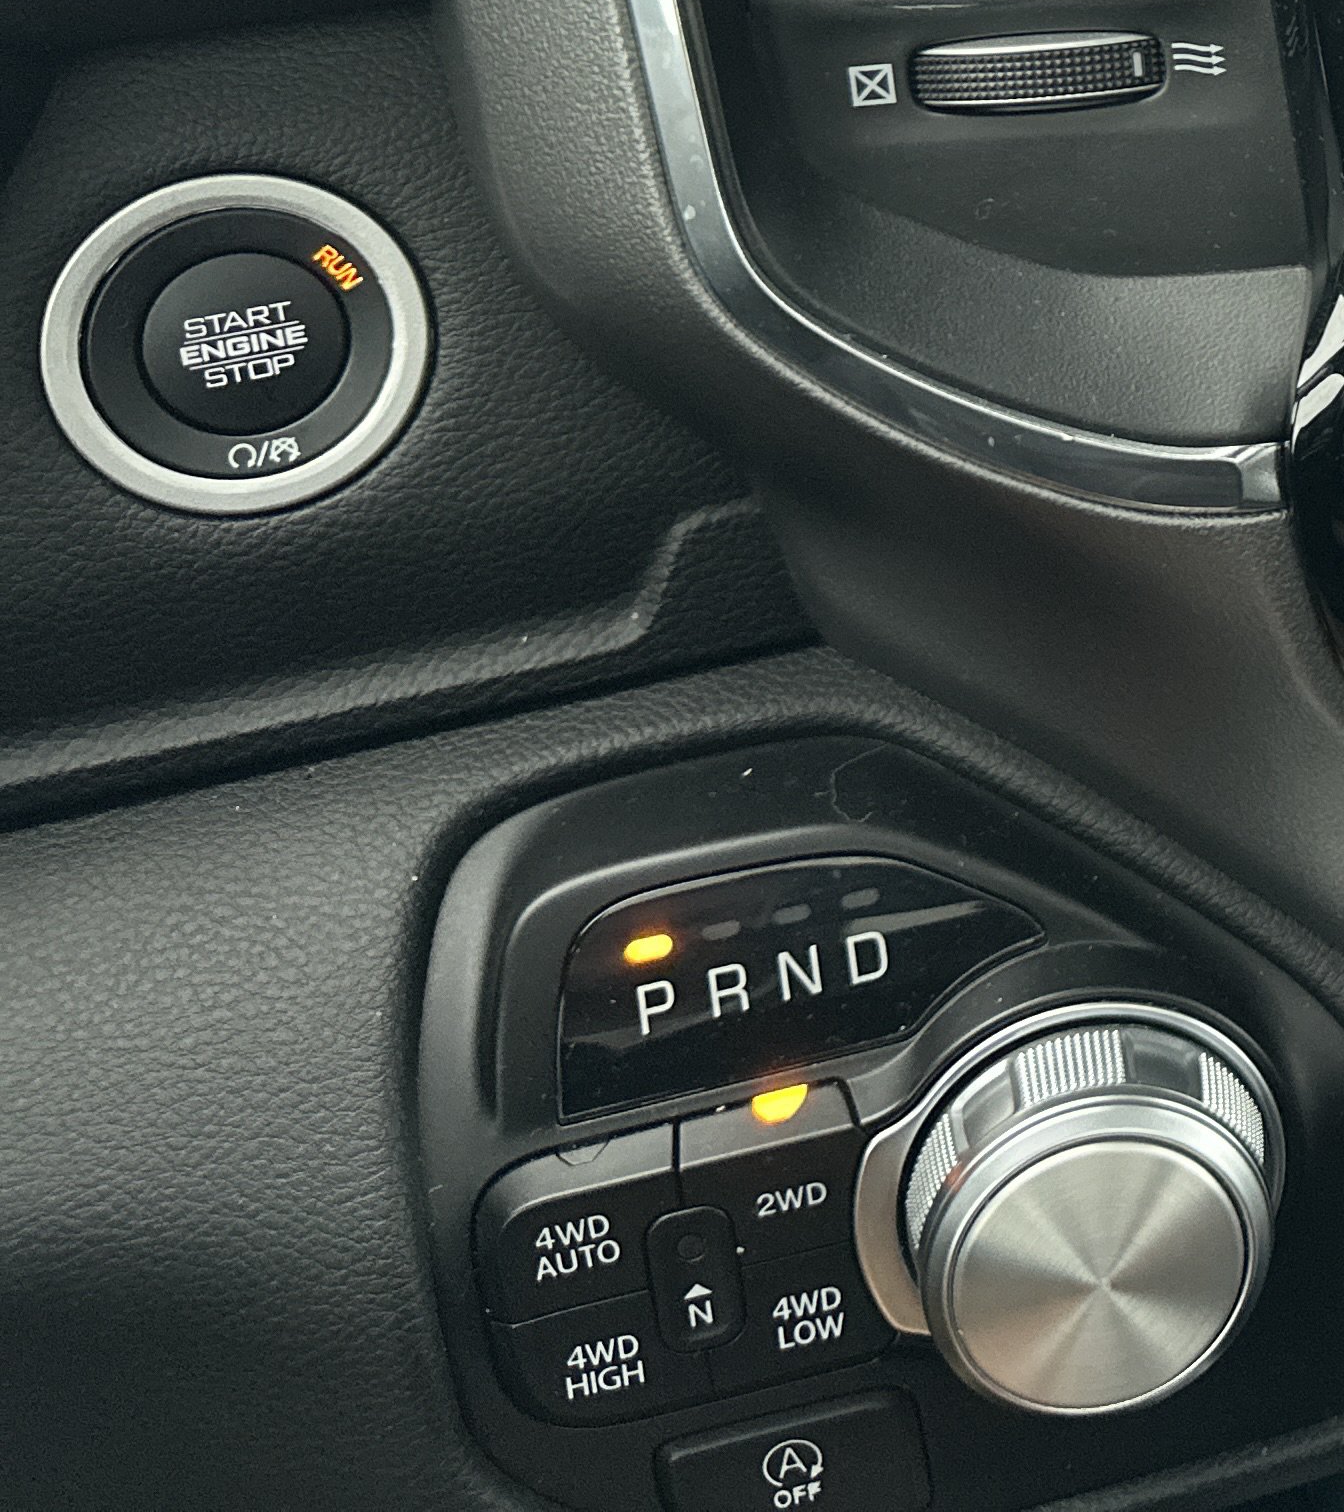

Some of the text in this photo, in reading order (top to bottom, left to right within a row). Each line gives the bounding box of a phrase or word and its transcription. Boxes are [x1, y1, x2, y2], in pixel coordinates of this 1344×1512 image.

[312, 244, 364, 291] RUN
[183, 300, 292, 341] START
[179, 324, 308, 367] ENGINE
[204, 353, 296, 390] STOP
[756, 1181, 827, 1219] 2WD
[535, 1214, 610, 1251] 4WD
[535, 1239, 621, 1283] AUTO
[687, 1300, 714, 1328] N
[771, 1286, 842, 1322] 4WD
[777, 1311, 845, 1350] LOW
[566, 1333, 640, 1370] 4WD
[565, 1359, 646, 1400] HIGH
[773, 1478, 823, 1509] OFF
